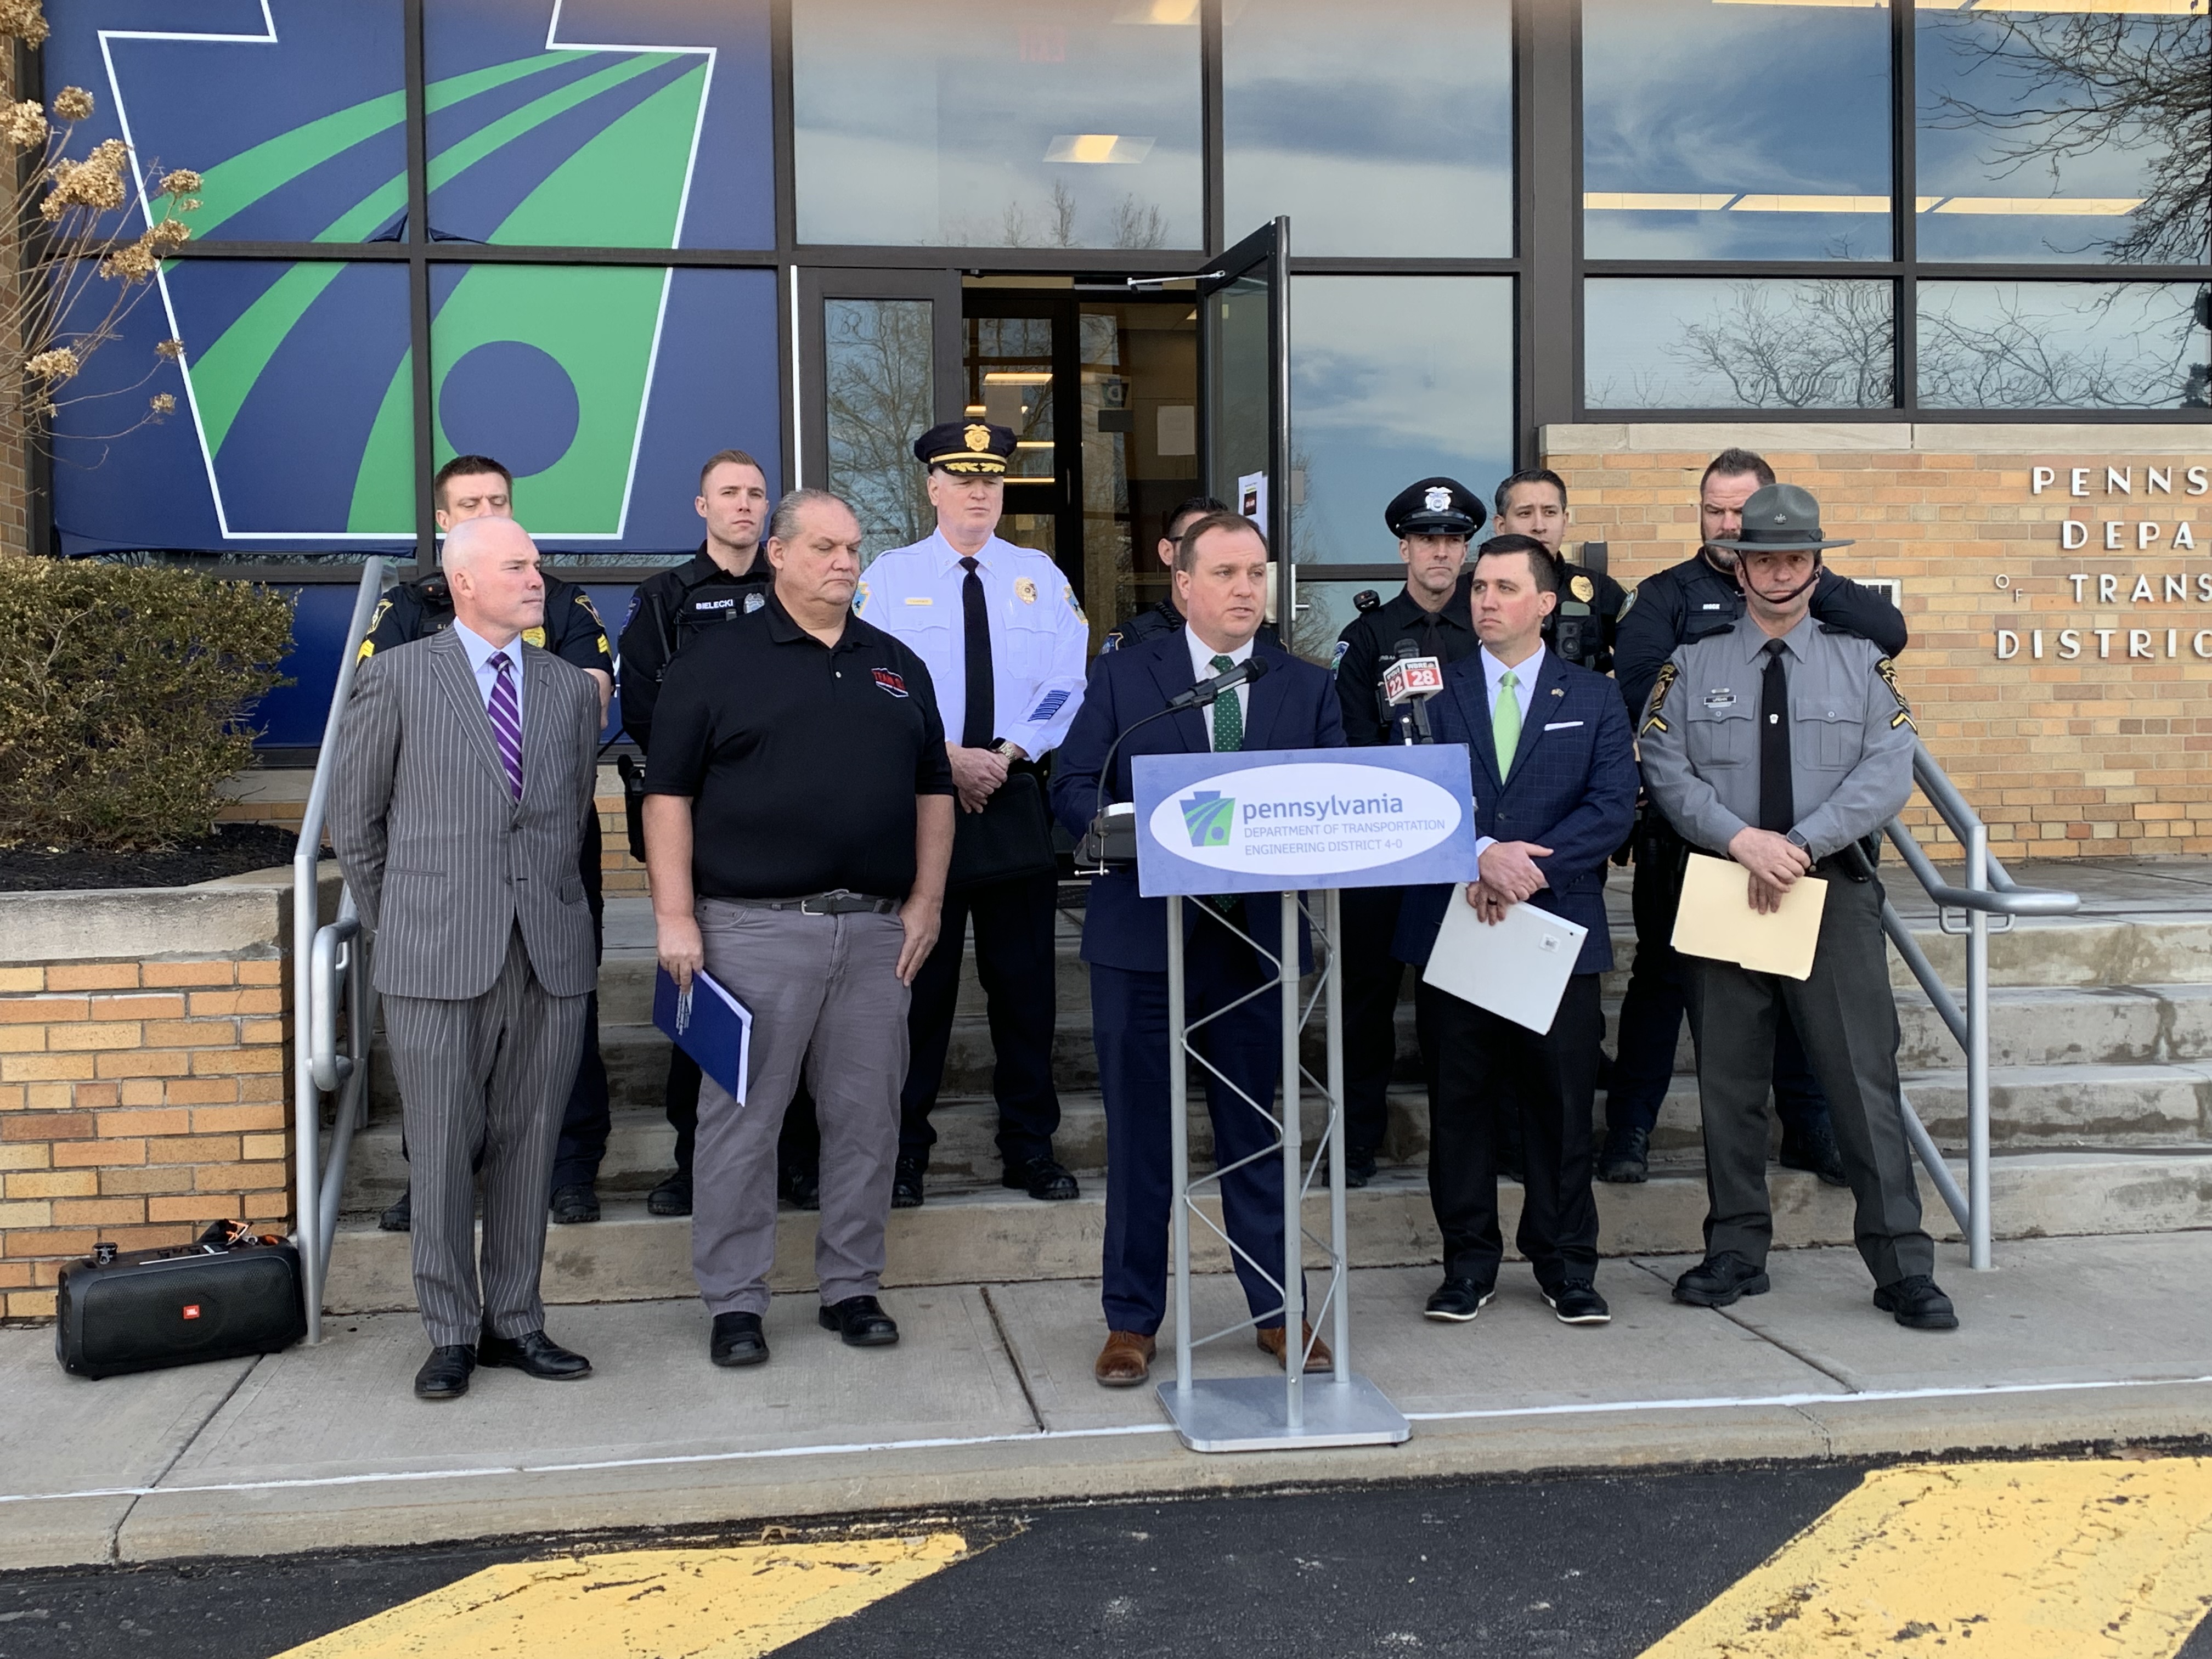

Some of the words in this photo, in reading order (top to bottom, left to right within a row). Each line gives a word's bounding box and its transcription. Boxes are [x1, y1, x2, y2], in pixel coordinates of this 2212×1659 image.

[2033, 466, 2209, 496] PENNS
[2062, 520, 2195, 550] DEPA
[2069, 573, 2212, 603] TRANS
[696, 599, 733, 610] BIELECKI
[1997, 629, 2212, 659] DISTRIC
[1390, 675, 1403, 697] 22
[1411, 670, 1435, 686] 28
[1243, 793, 1403, 825] pennsylvania
[1244, 824, 1321, 838] DEPARTMENT
[1323, 823, 1339, 835] OF
[1341, 819, 1446, 834] TRANSPORTATION
[1245, 842, 1325, 856] ENGINEERING
[1328, 839, 1382, 852] DISTRICT
[1384, 838, 1403, 849] 4-0
